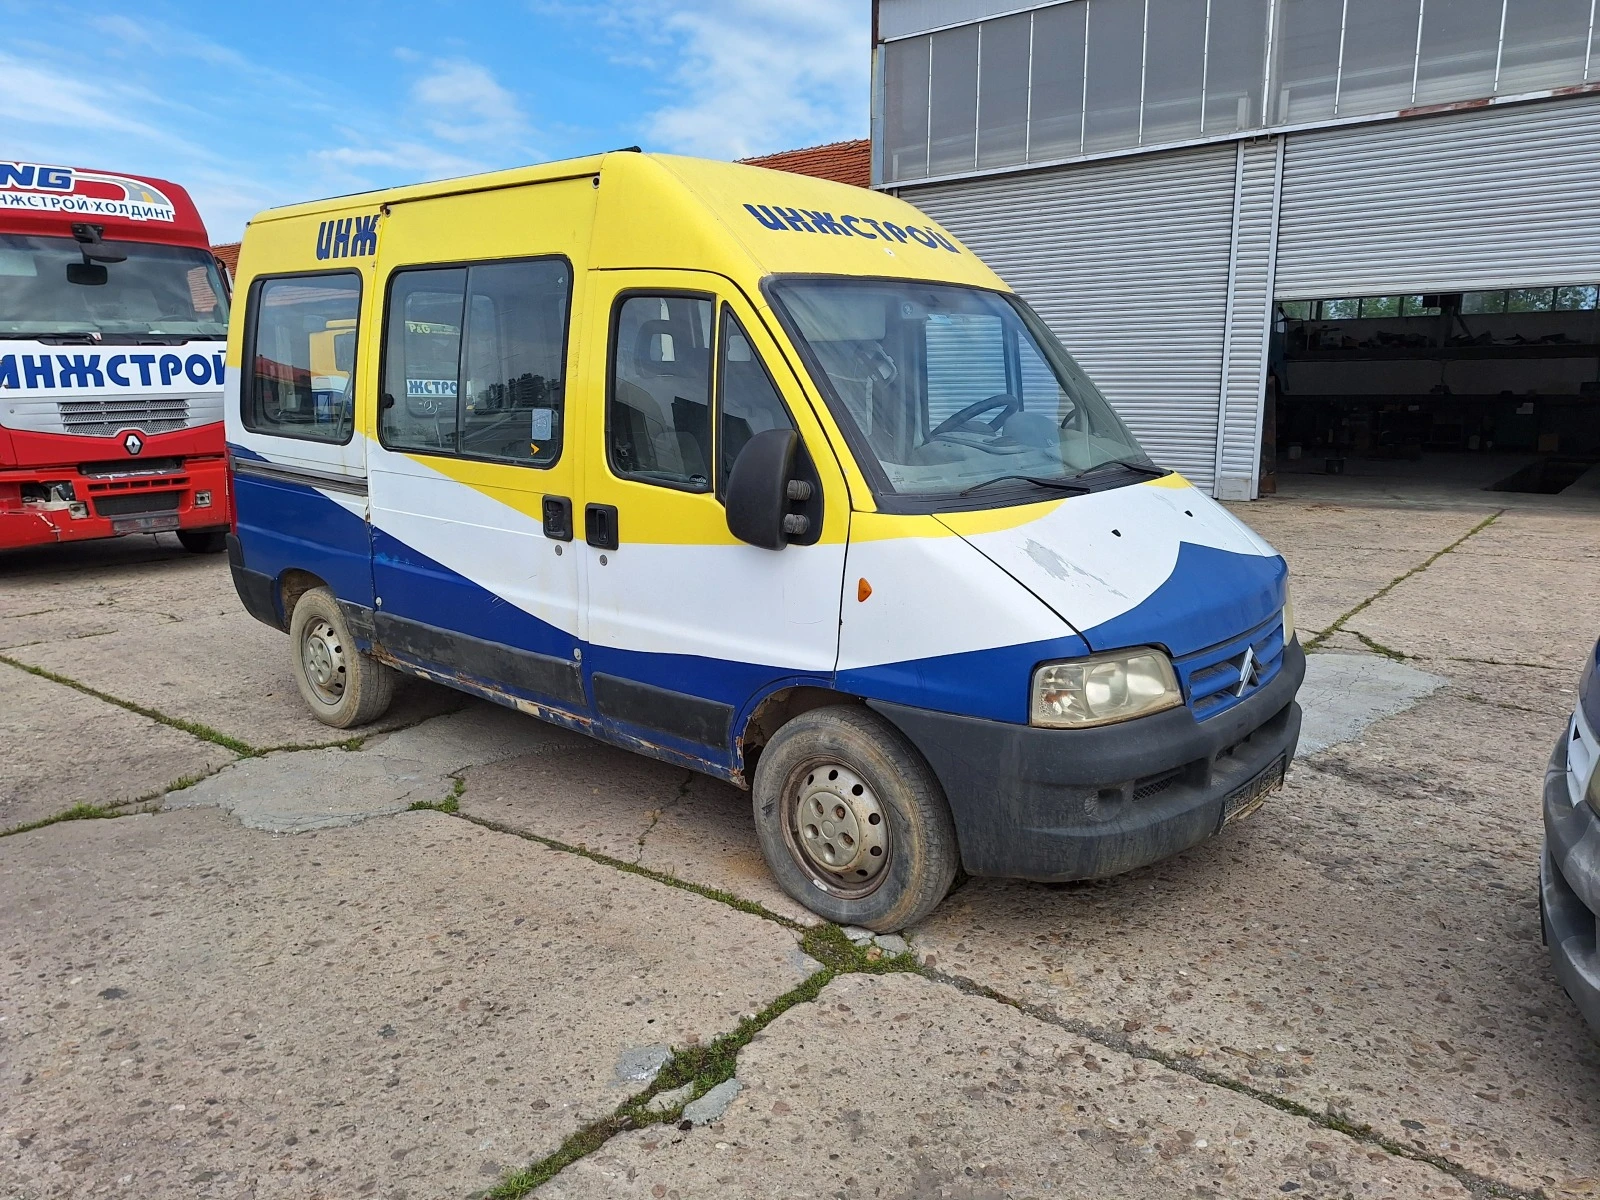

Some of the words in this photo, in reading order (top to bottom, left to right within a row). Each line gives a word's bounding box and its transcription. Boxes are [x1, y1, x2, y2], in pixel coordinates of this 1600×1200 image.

[94, 201, 173, 220] ХОЛДИНГ
[742, 203, 962, 254] ИНЖСТРОЙ
[316, 213, 381, 261] ИНЖ
